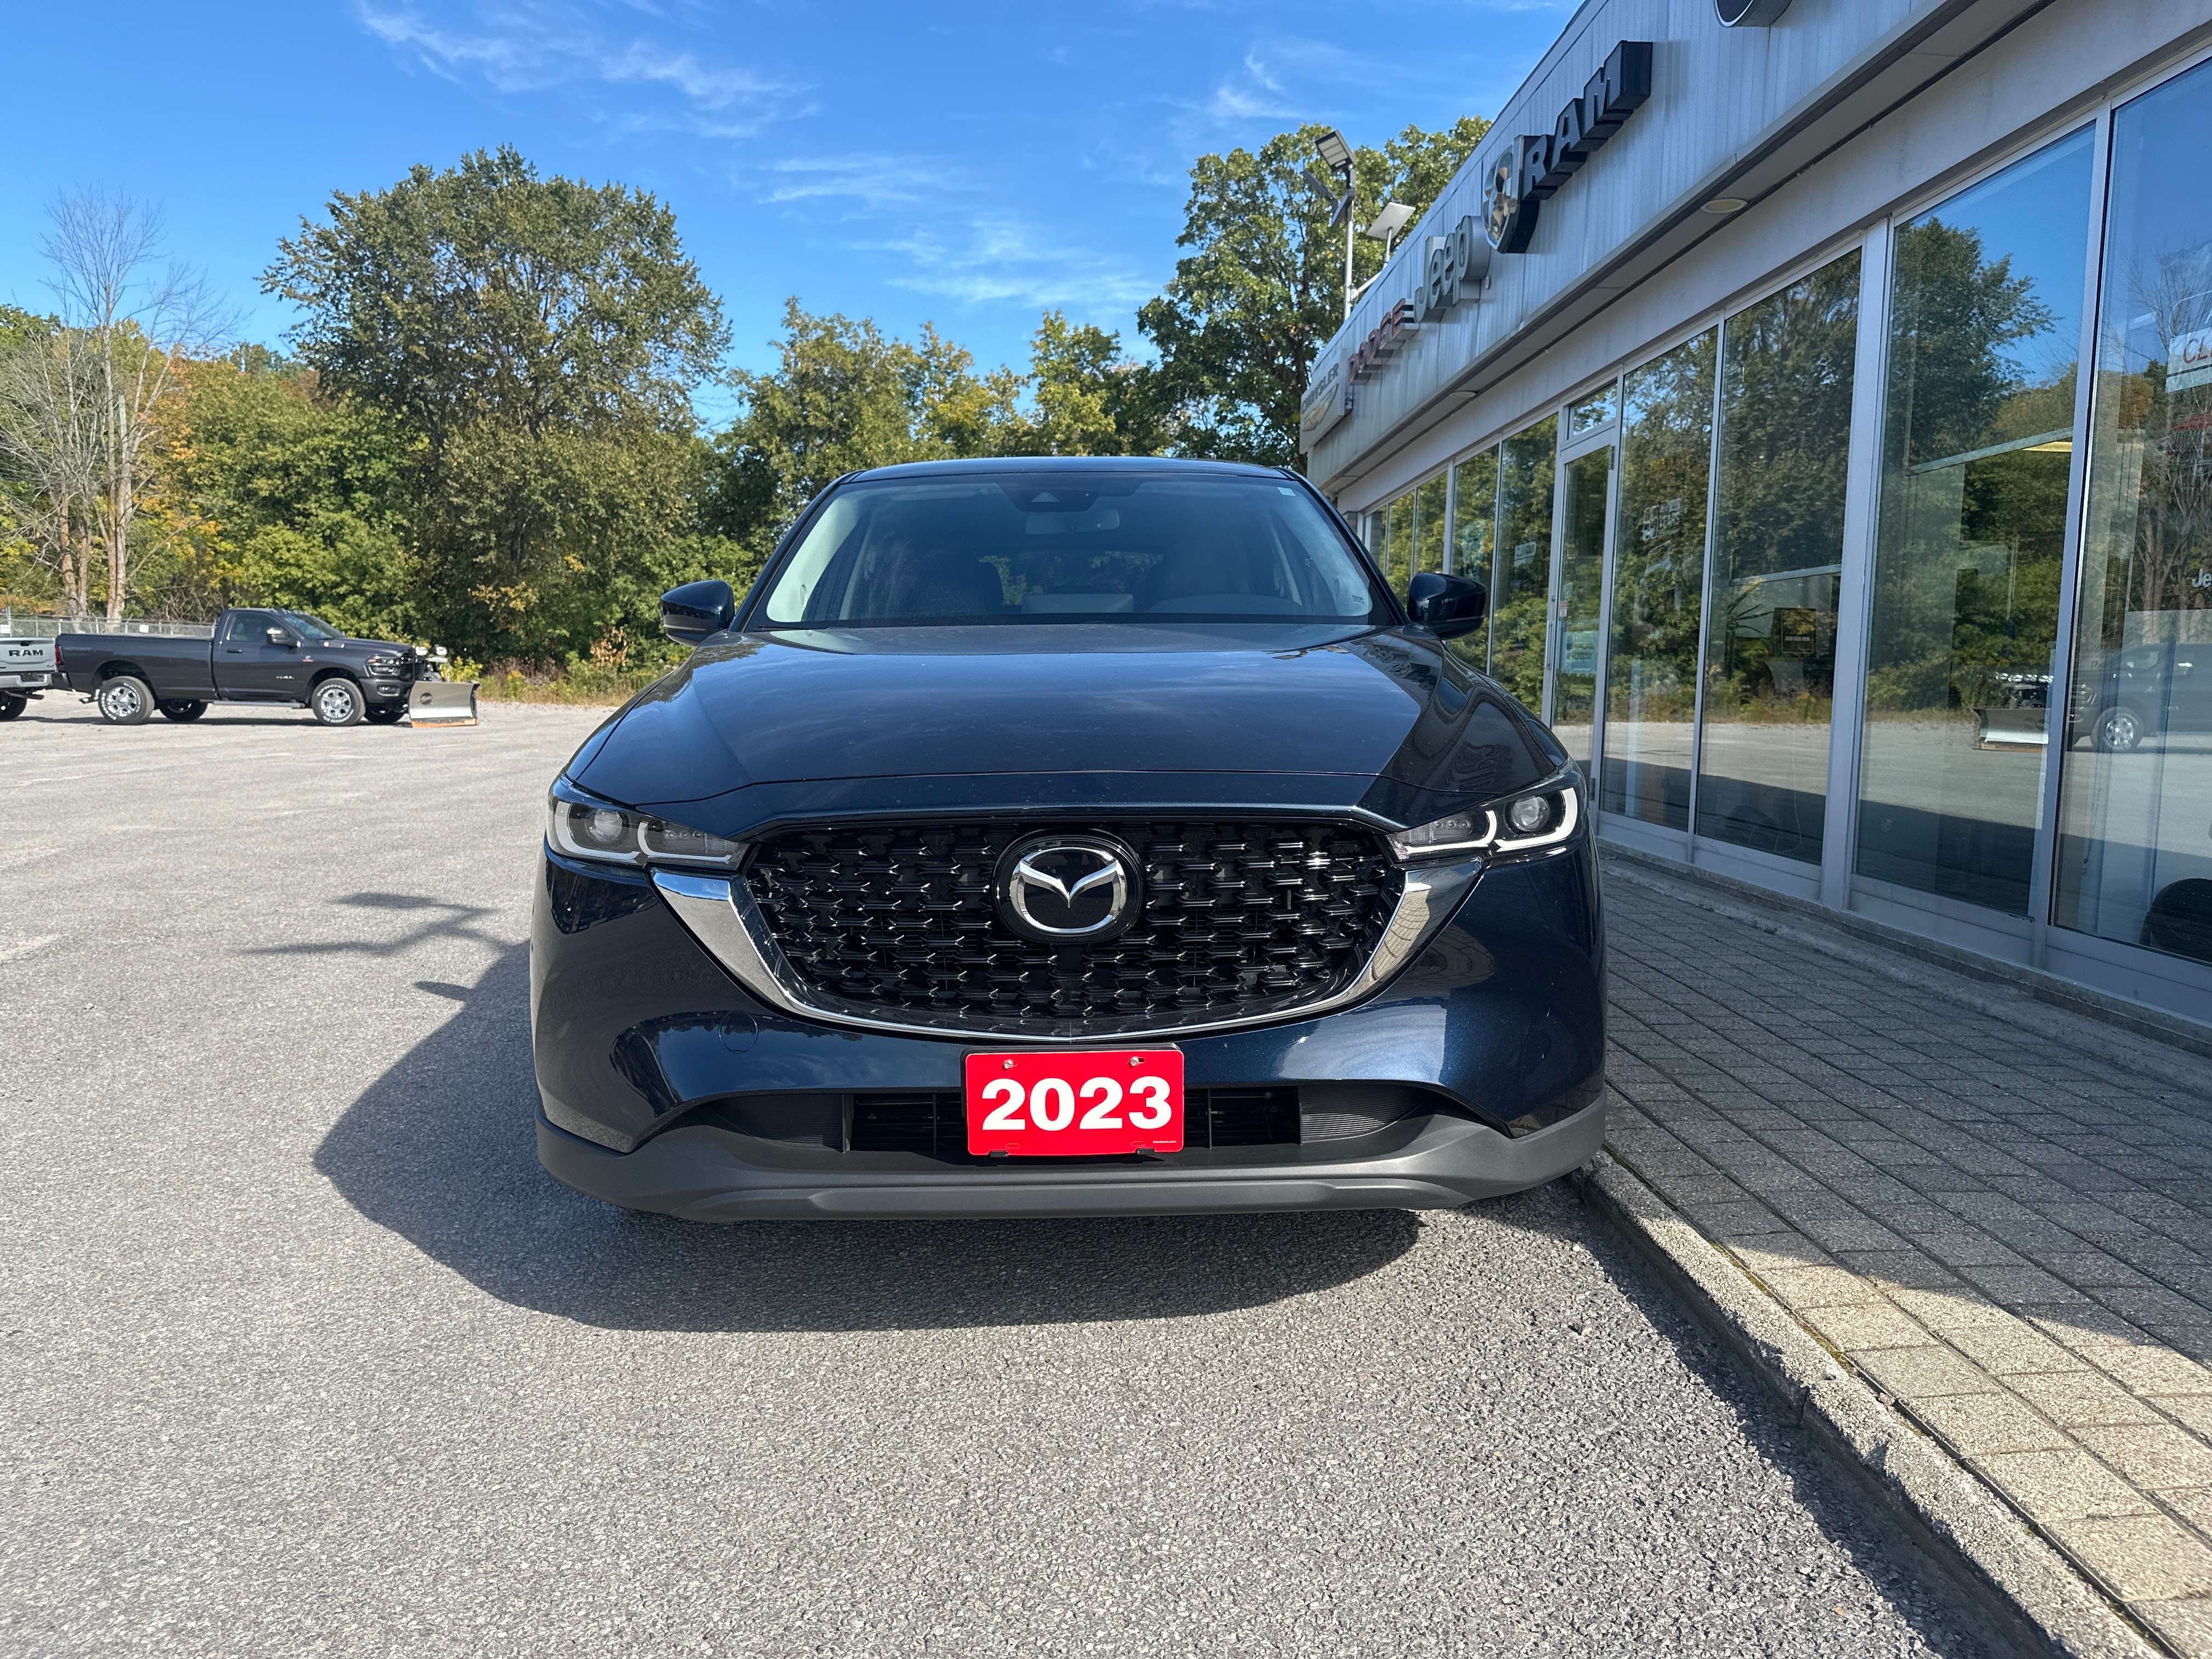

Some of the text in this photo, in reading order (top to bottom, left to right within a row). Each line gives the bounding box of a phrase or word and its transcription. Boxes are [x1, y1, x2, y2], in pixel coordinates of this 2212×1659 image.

[1523, 40, 1623, 201] RAM
[1414, 215, 1472, 323] Jeep
[1348, 298, 1406, 385] DODGE
[2183, 337, 2212, 364] CL
[982, 1076, 1172, 1131] 2023
